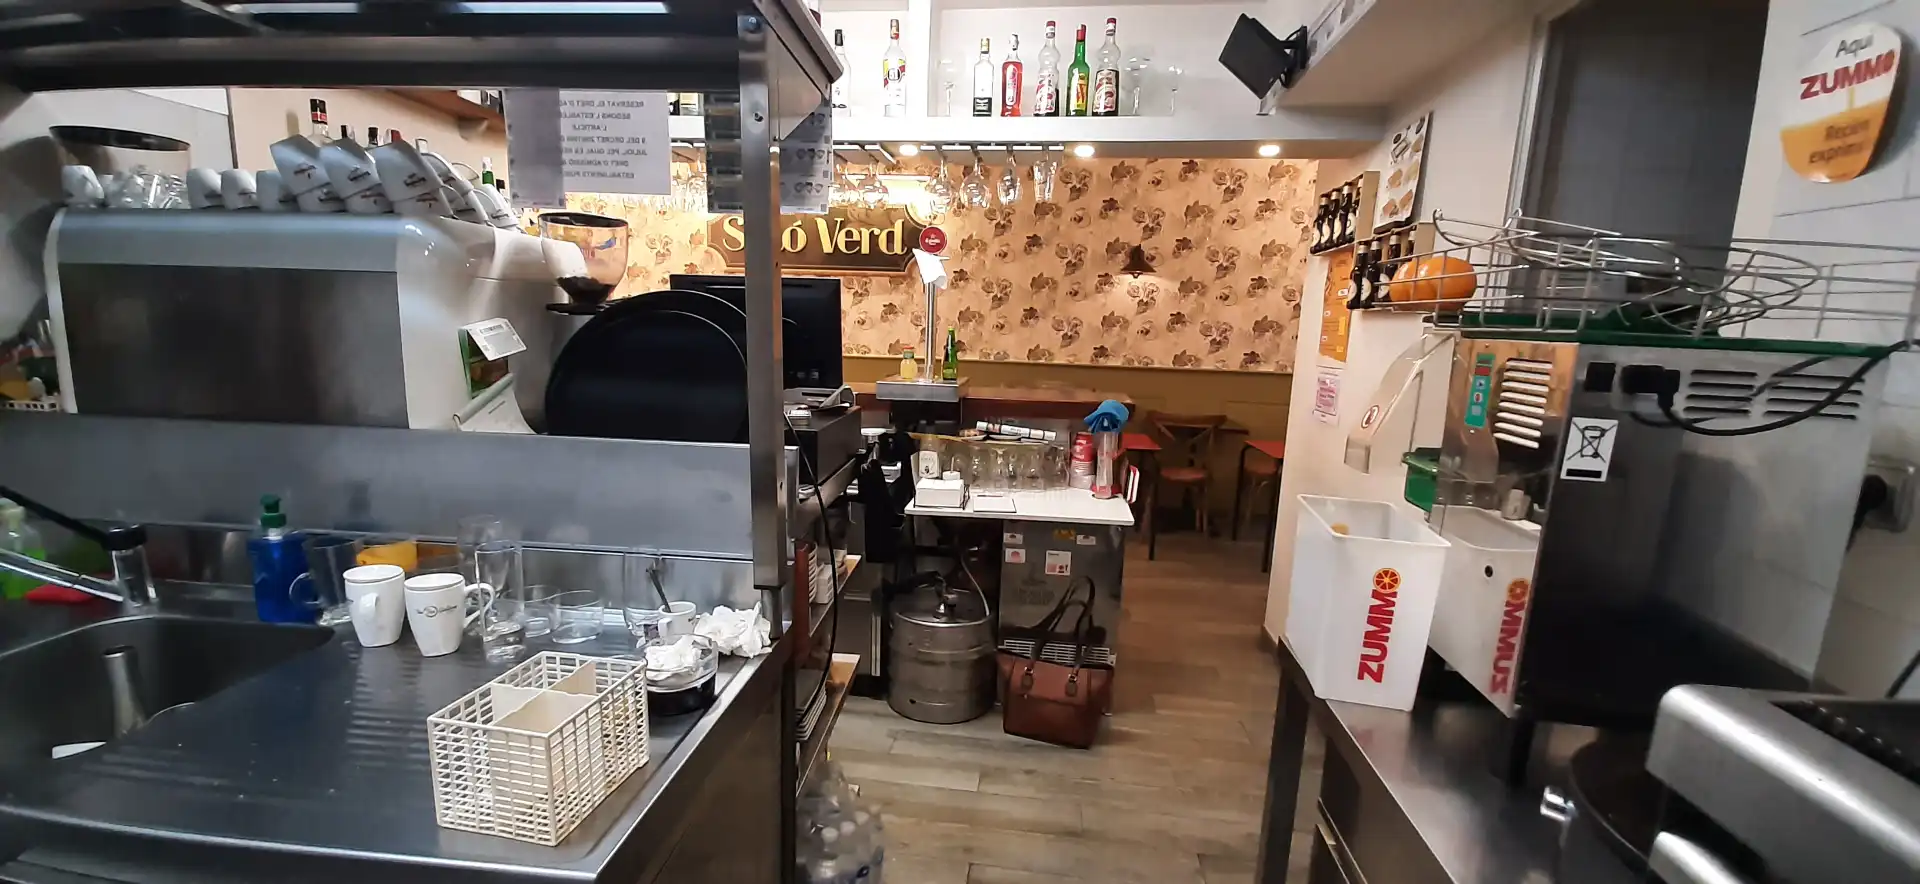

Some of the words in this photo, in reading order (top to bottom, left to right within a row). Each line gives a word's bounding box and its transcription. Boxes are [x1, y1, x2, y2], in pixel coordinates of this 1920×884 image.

[1800, 49, 1896, 100] ZUMMO
[815, 217, 908, 255] Verd
[1357, 568, 1401, 684] ZUMMO
